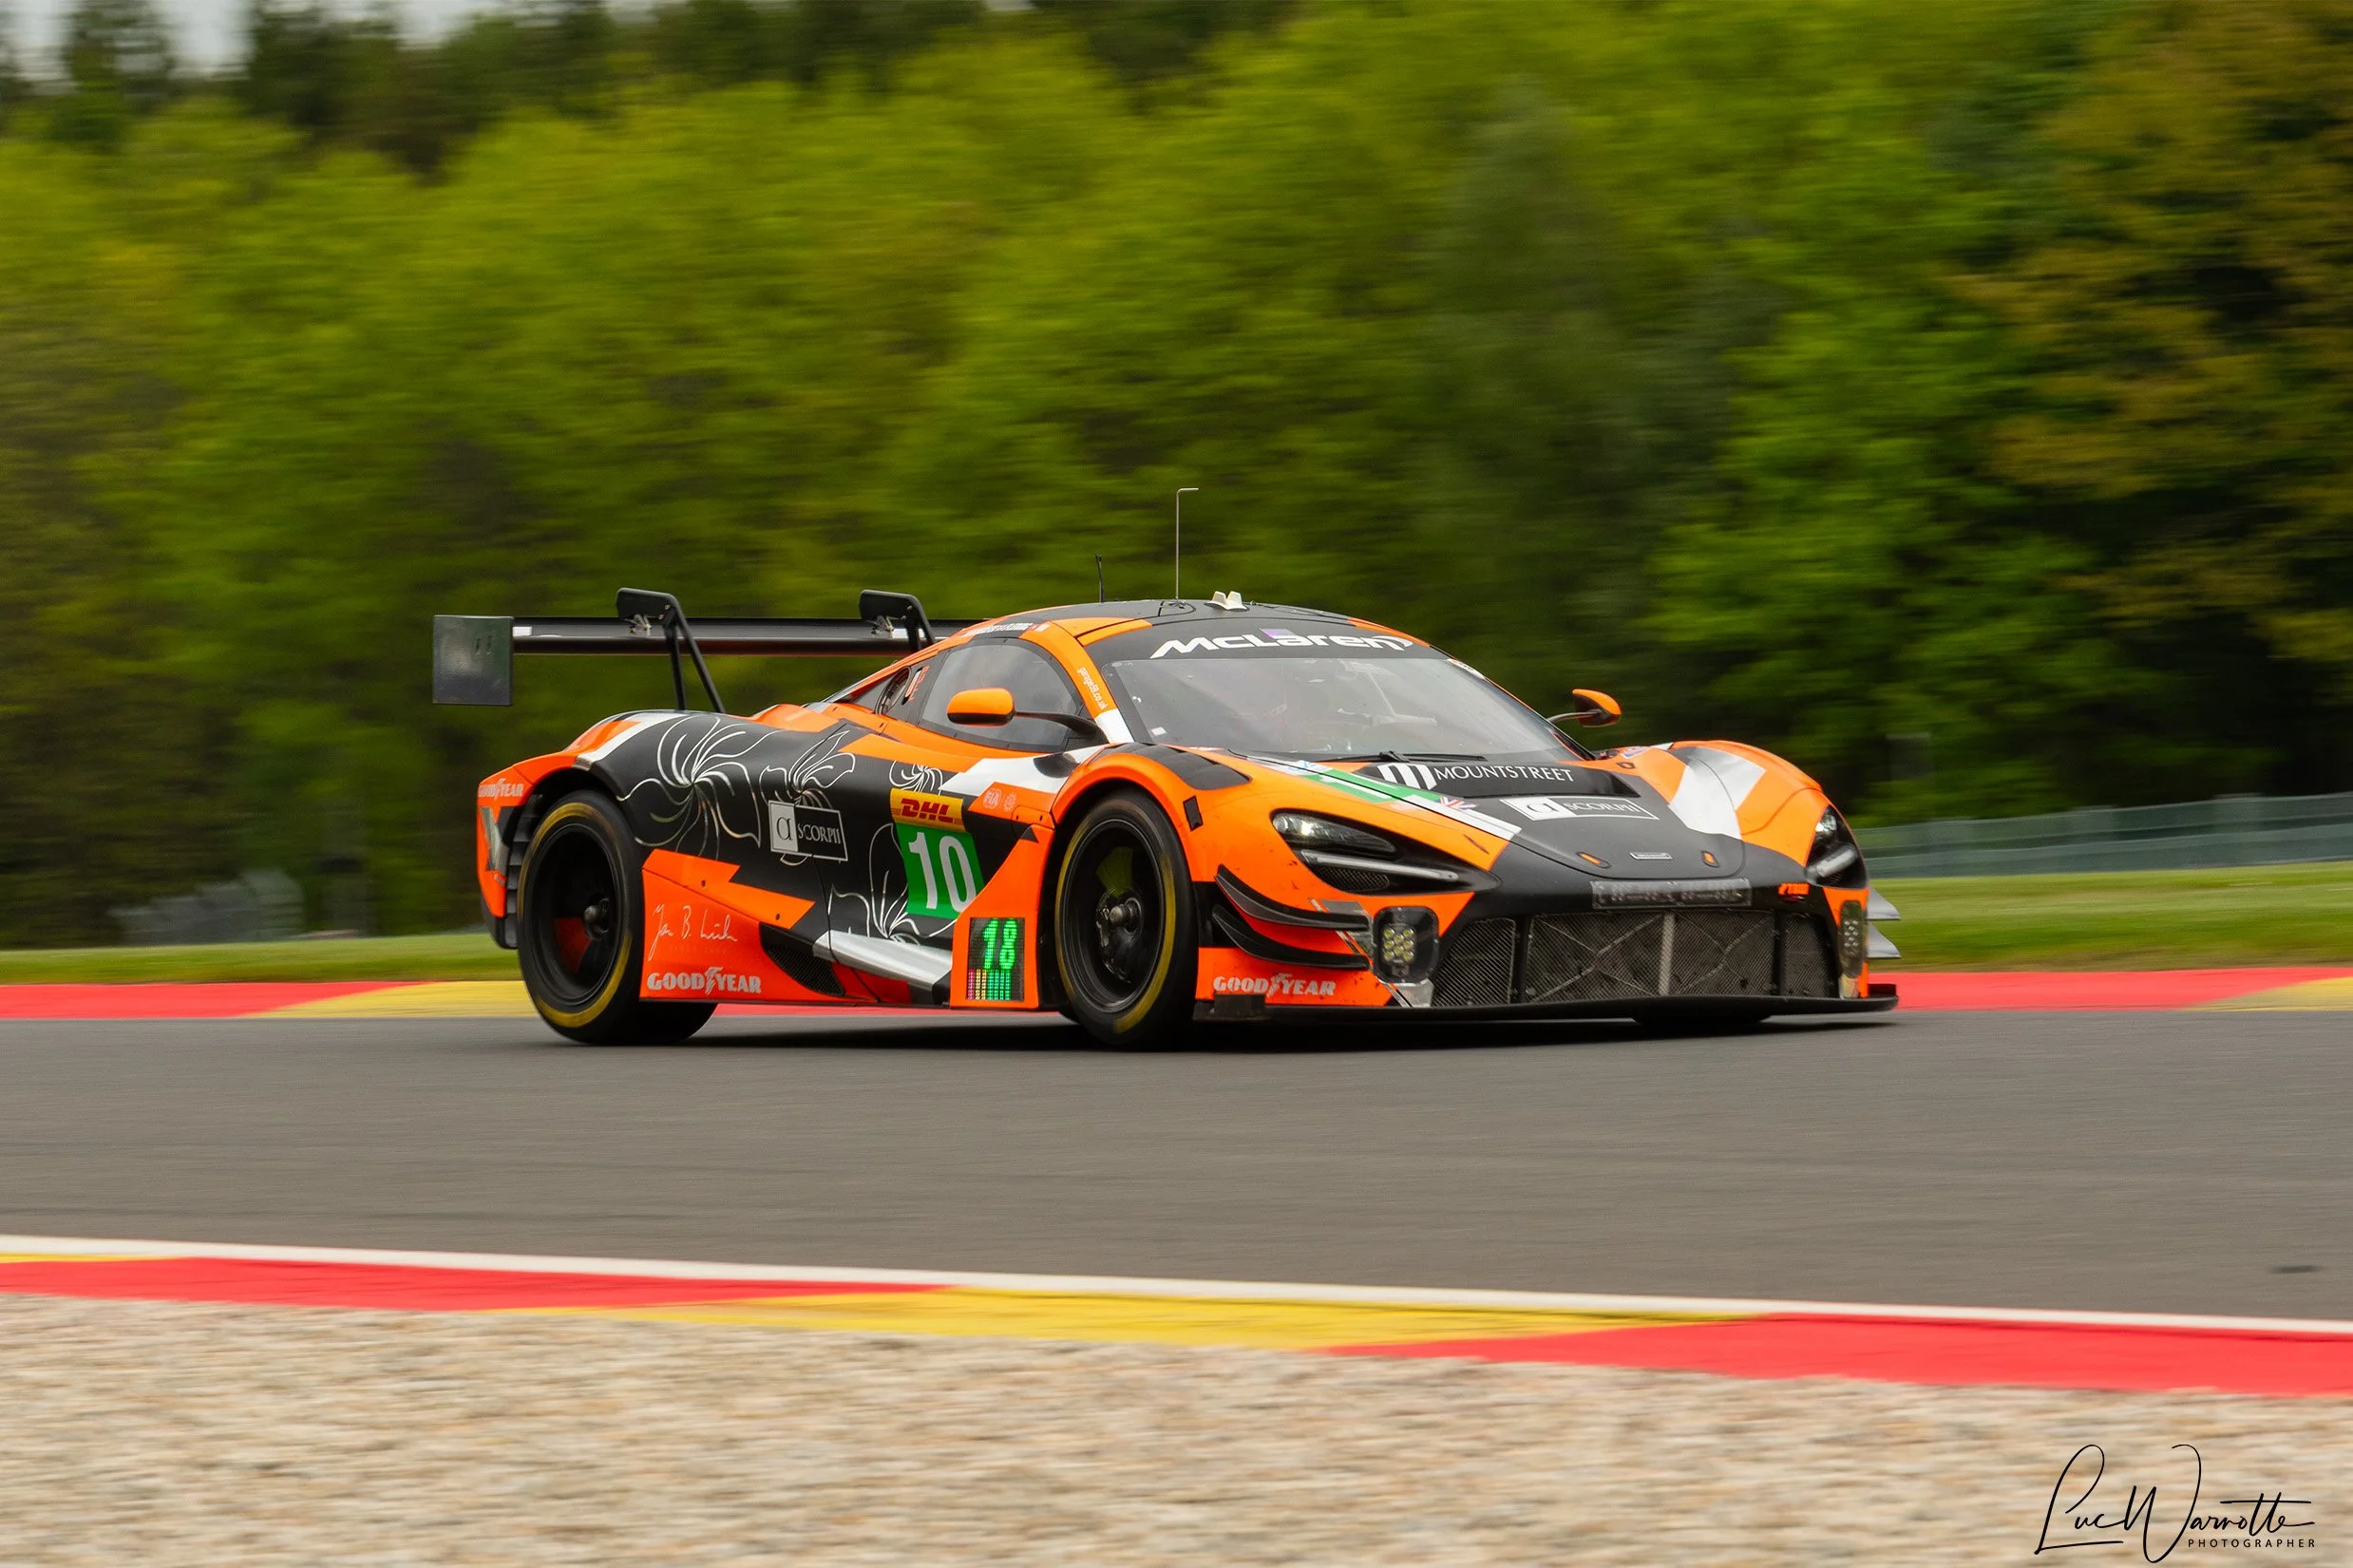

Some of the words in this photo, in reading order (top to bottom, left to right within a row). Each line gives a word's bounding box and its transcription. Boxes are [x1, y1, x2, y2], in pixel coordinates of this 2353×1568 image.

[1149, 634, 1414, 659] McLaren
[1433, 765, 1575, 783] MOUNTSTREET
[478, 780, 524, 799] GOODYEAR
[901, 798, 954, 823] DHL
[908, 831, 977, 914] 10
[982, 917, 1018, 970] 18
[647, 968, 762, 995] GOODYEAR
[1213, 974, 1337, 996] GOODYEAR
